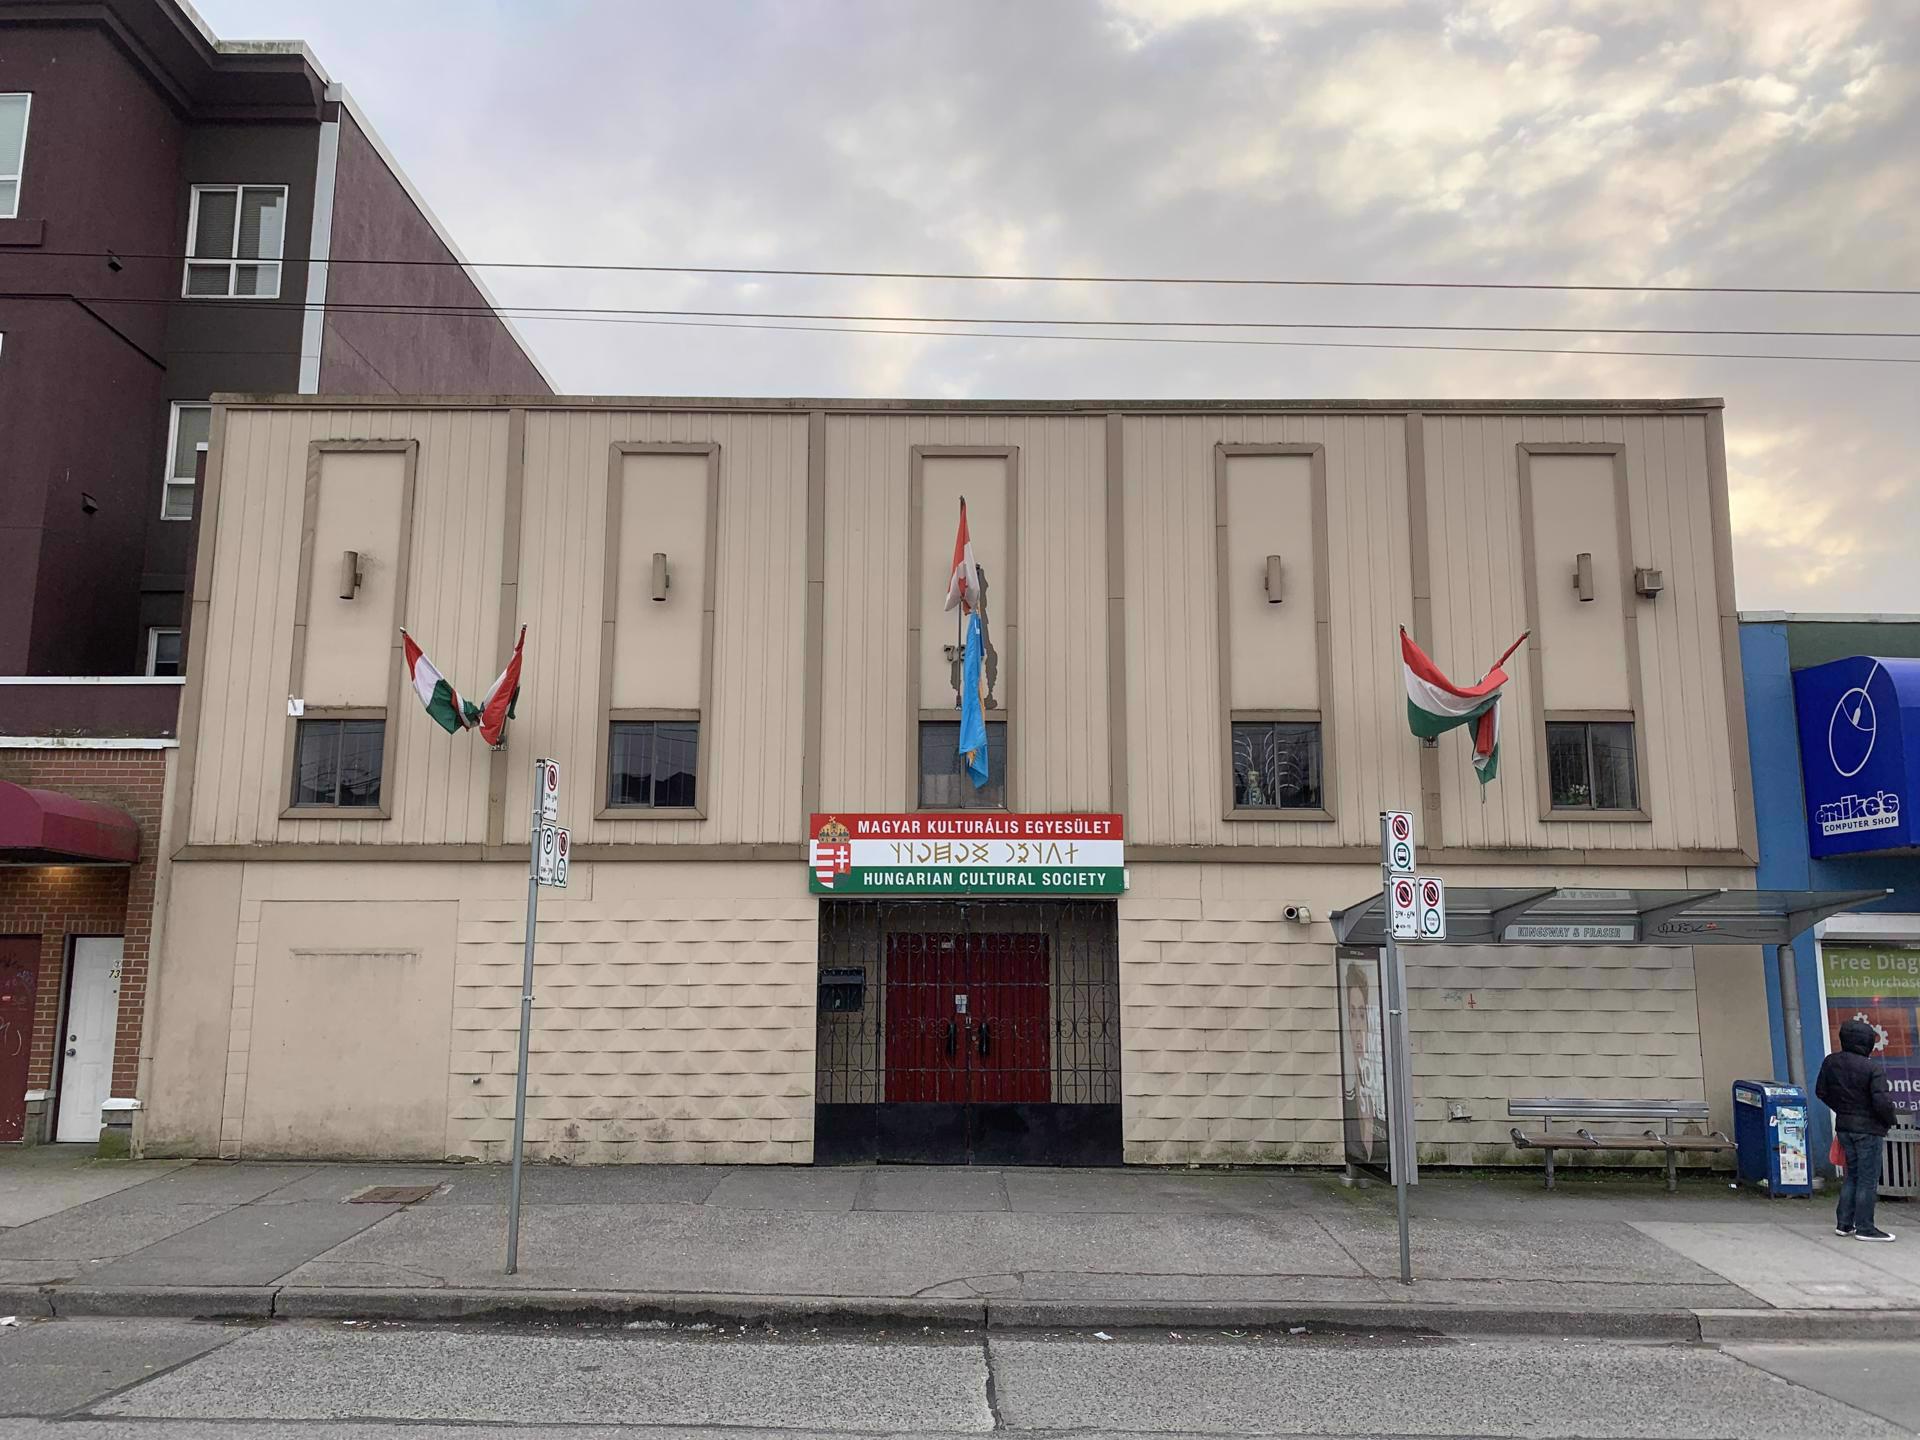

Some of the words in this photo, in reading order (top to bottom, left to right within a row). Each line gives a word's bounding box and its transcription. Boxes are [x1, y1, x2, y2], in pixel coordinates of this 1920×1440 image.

[1816, 790, 1900, 825] mike's
[857, 820, 921, 834] MAGYAR
[927, 817, 1019, 834] KULTURÁLIS
[1025, 817, 1111, 834] EGYESÜLET
[1824, 819, 1870, 832] COMPUTER
[1872, 815, 1897, 826] SHOP
[863, 872, 953, 886] HUNGARIAN
[959, 872, 1036, 886] CULTURAL
[1042, 872, 1107, 886] SOCIETY
[1517, 927, 1571, 938] KINGSWAY
[1573, 927, 1580, 938] &
[1583, 927, 1621, 938] FRASER
[1829, 954, 1871, 970] Free
[1876, 953, 1920, 975] Diag
[109, 969, 122, 979] 73
[1831, 975, 1859, 988] with
